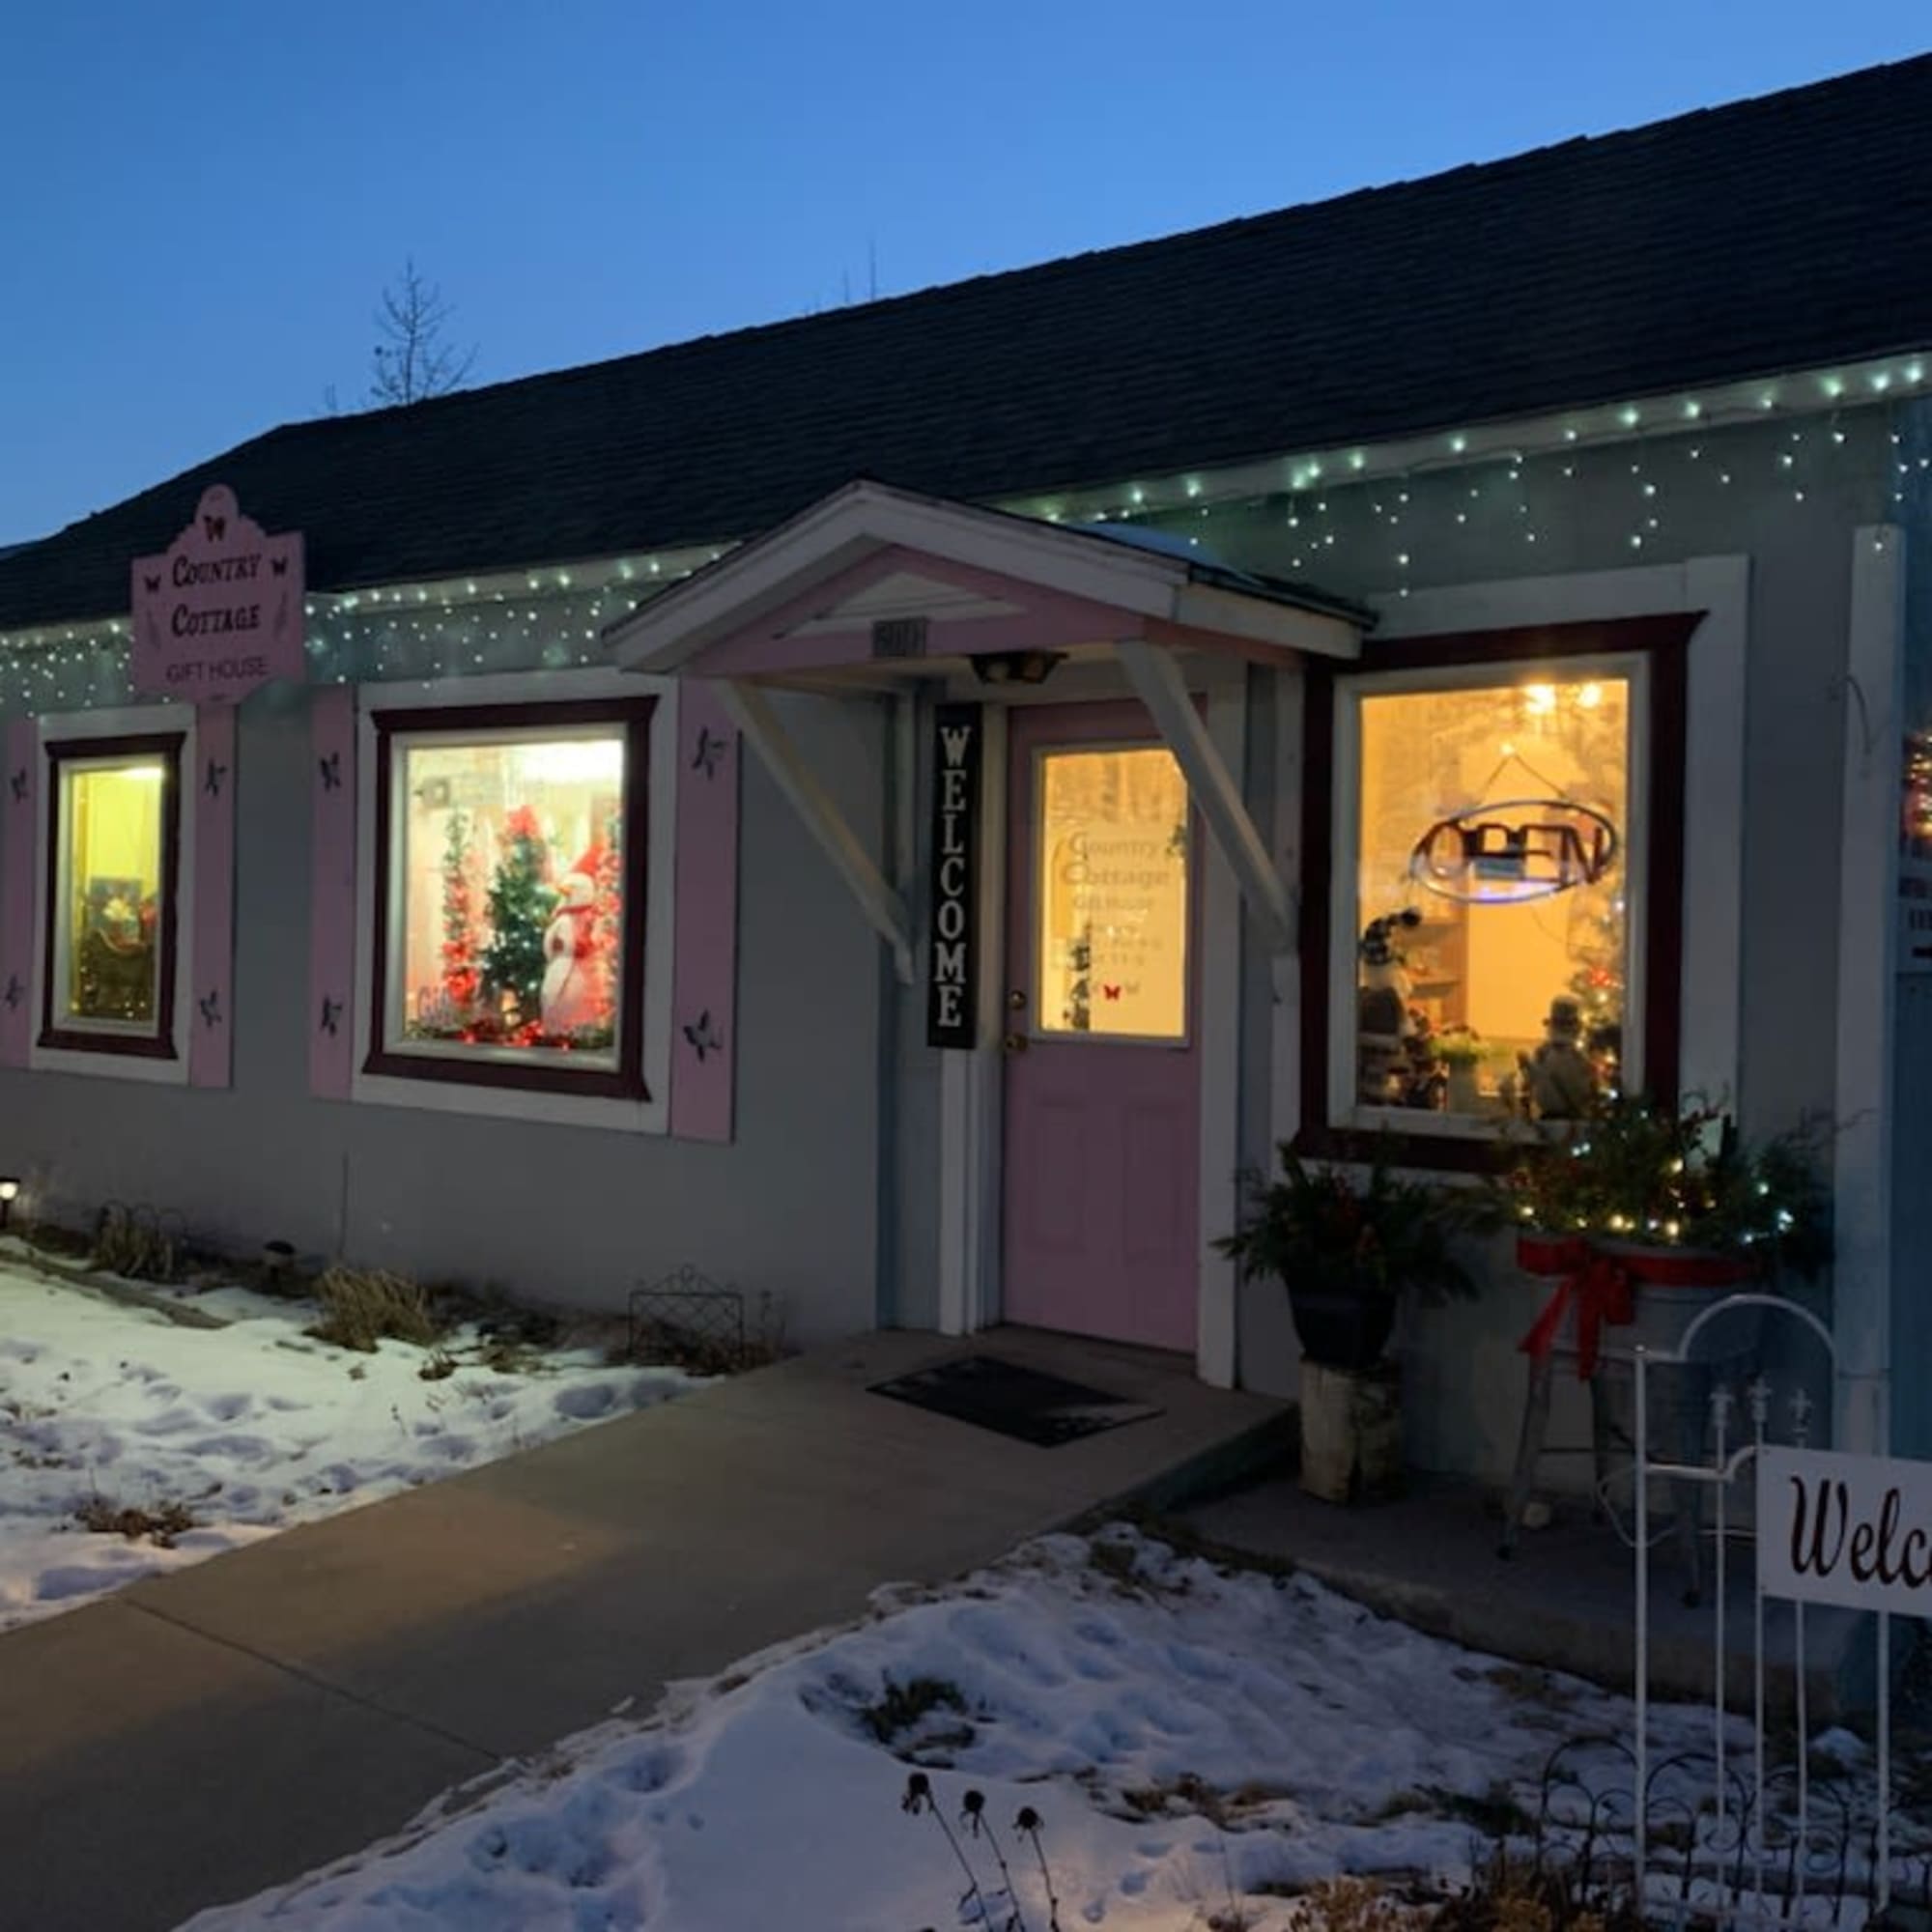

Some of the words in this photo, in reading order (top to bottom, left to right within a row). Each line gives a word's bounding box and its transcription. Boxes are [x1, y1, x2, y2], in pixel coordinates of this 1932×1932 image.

[171, 603, 261, 638] COTTAGE
[165, 661, 203, 684] GIFT
[209, 656, 270, 680] HOUSE
[934, 725, 972, 1028] WELCOME
[1424, 820, 1604, 885] OPEN
[1790, 1475, 1932, 1589] Welc
